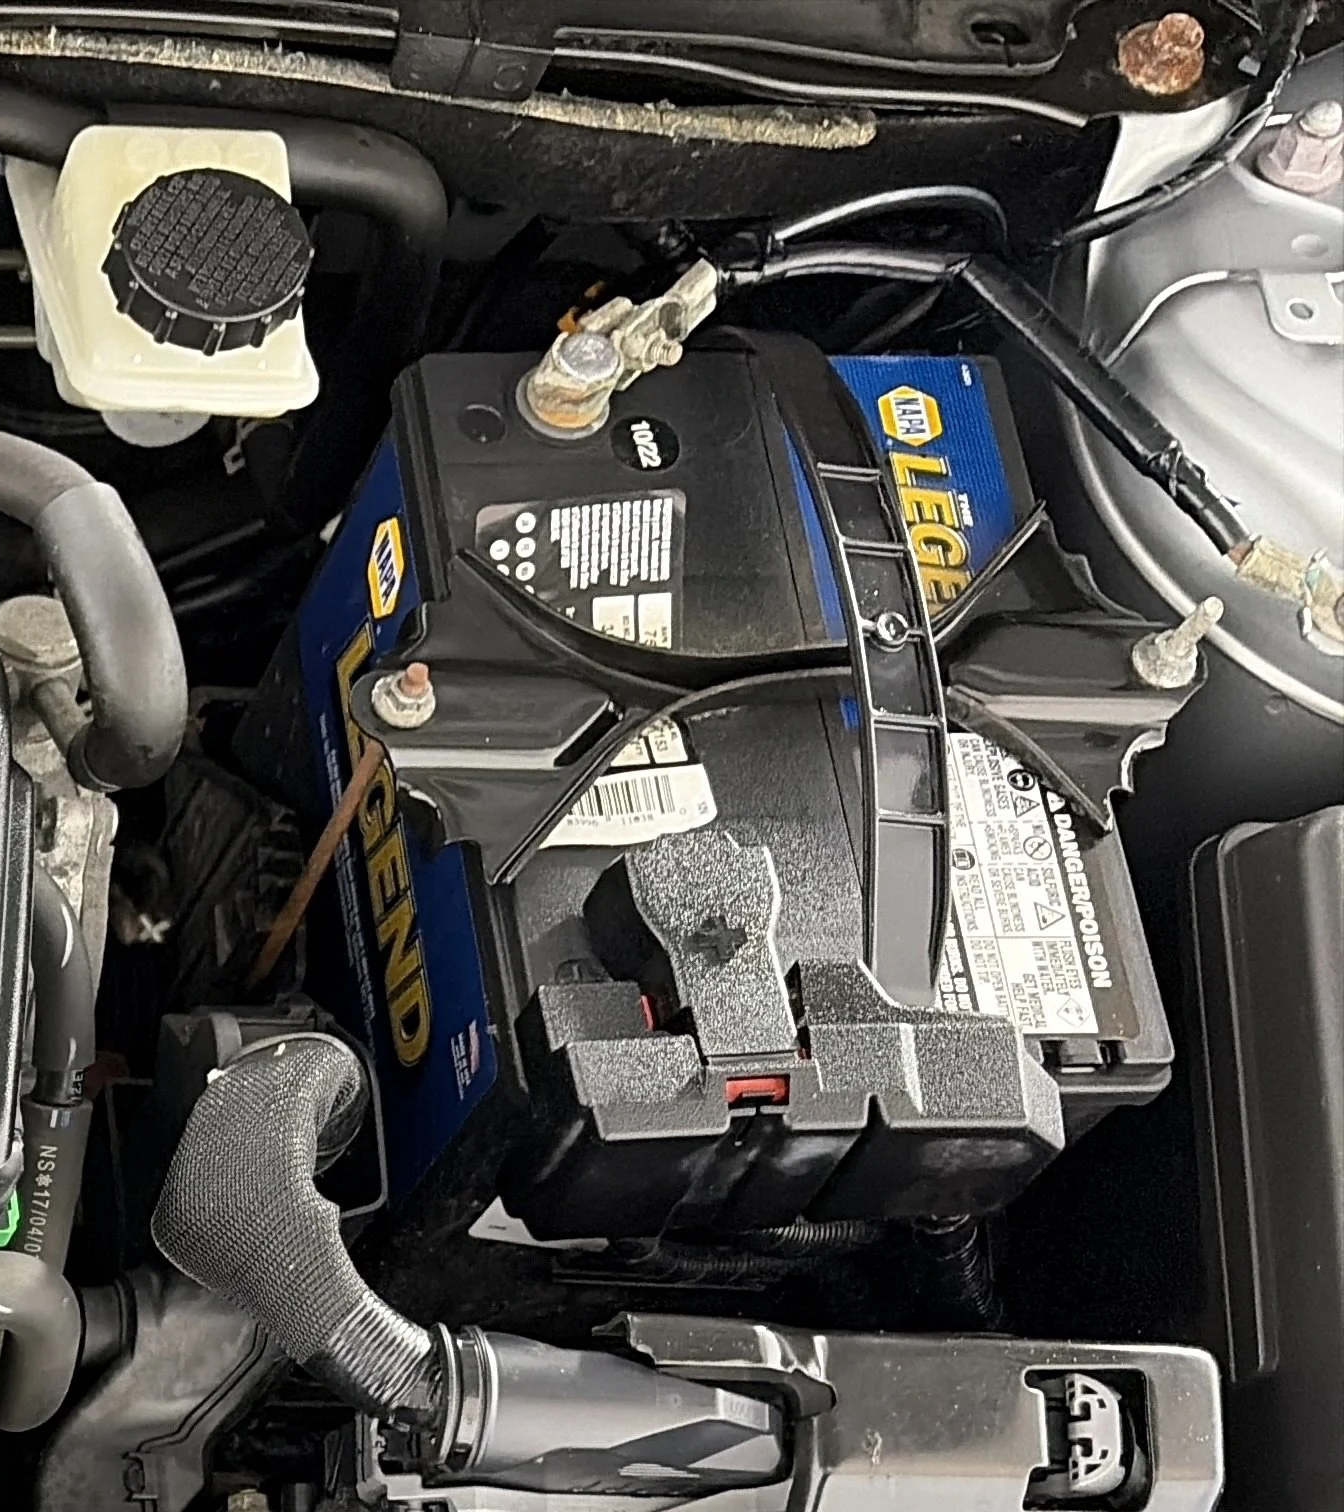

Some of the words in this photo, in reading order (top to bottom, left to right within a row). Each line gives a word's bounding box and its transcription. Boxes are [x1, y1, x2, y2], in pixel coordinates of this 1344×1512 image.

[631, 420, 662, 468] 10/22
[893, 397, 926, 435] NAPA
[890, 451, 974, 617] LEGE
[958, 493, 974, 527] THE
[375, 529, 396, 608] NAPA
[336, 614, 432, 1067] LGEND
[1054, 813, 1112, 988] DANGER/POISON
